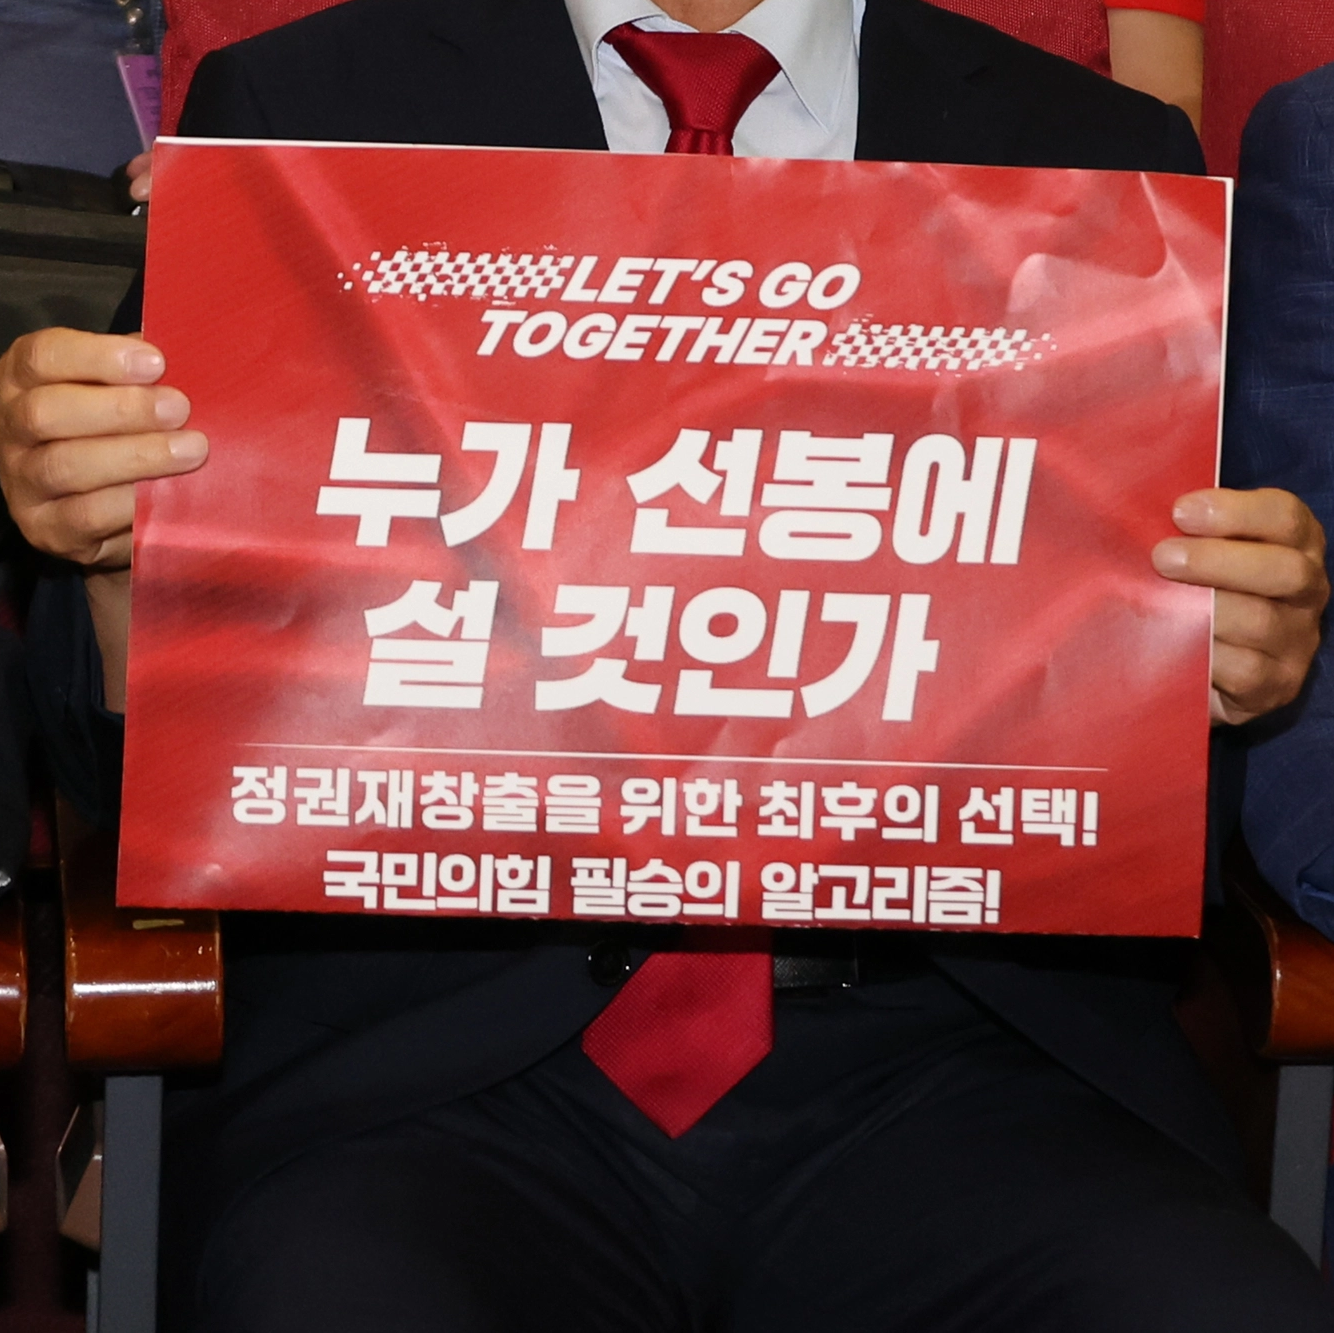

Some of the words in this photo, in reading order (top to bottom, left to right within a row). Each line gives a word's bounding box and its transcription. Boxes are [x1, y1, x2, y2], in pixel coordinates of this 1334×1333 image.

[562, 255, 749, 307] LET'S
[758, 262, 861, 310] GO
[476, 309, 827, 367] TOGETHER
[315, 417, 581, 551] 누가
[626, 428, 1037, 565] 선봉에
[362, 580, 499, 709] 설
[534, 584, 940, 722] 것인가
[231, 766, 602, 834] 정권재창출을
[620, 777, 743, 837] 위한
[757, 780, 939, 843] 최후의
[958, 787, 1098, 847] 선택!
[323, 850, 551, 914] 국민의힘
[570, 857, 741, 918] 필승의
[760, 862, 1001, 925] 알고리즘!
